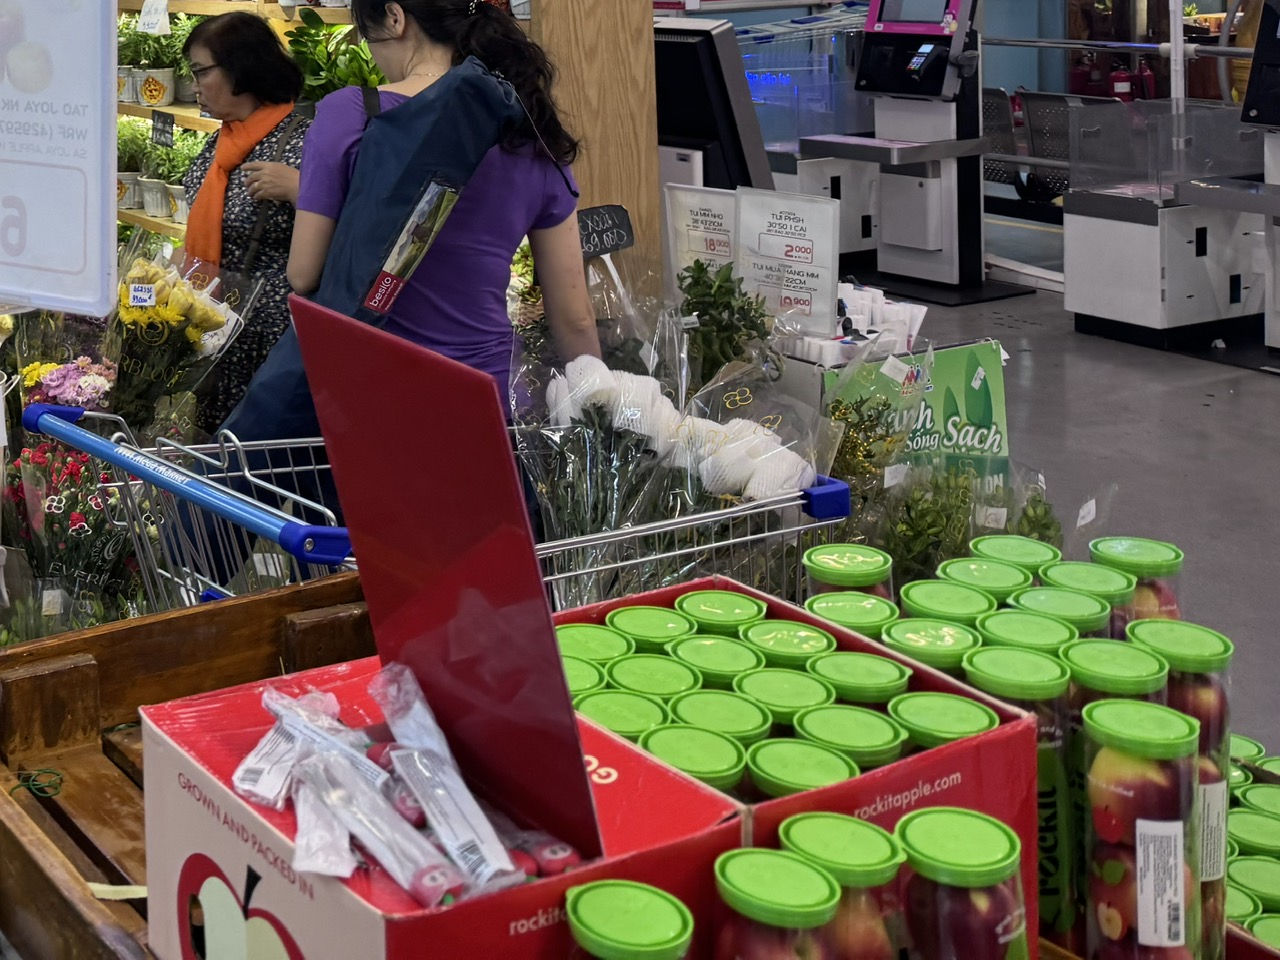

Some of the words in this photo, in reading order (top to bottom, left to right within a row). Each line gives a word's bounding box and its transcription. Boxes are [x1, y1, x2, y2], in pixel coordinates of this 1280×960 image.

[177, 772, 221, 821] GROWN
[222, 811, 250, 844] AND
[251, 833, 297, 885] PACKED
[298, 874, 314, 901] IN
[854, 768, 962, 820] rockitapple.com
